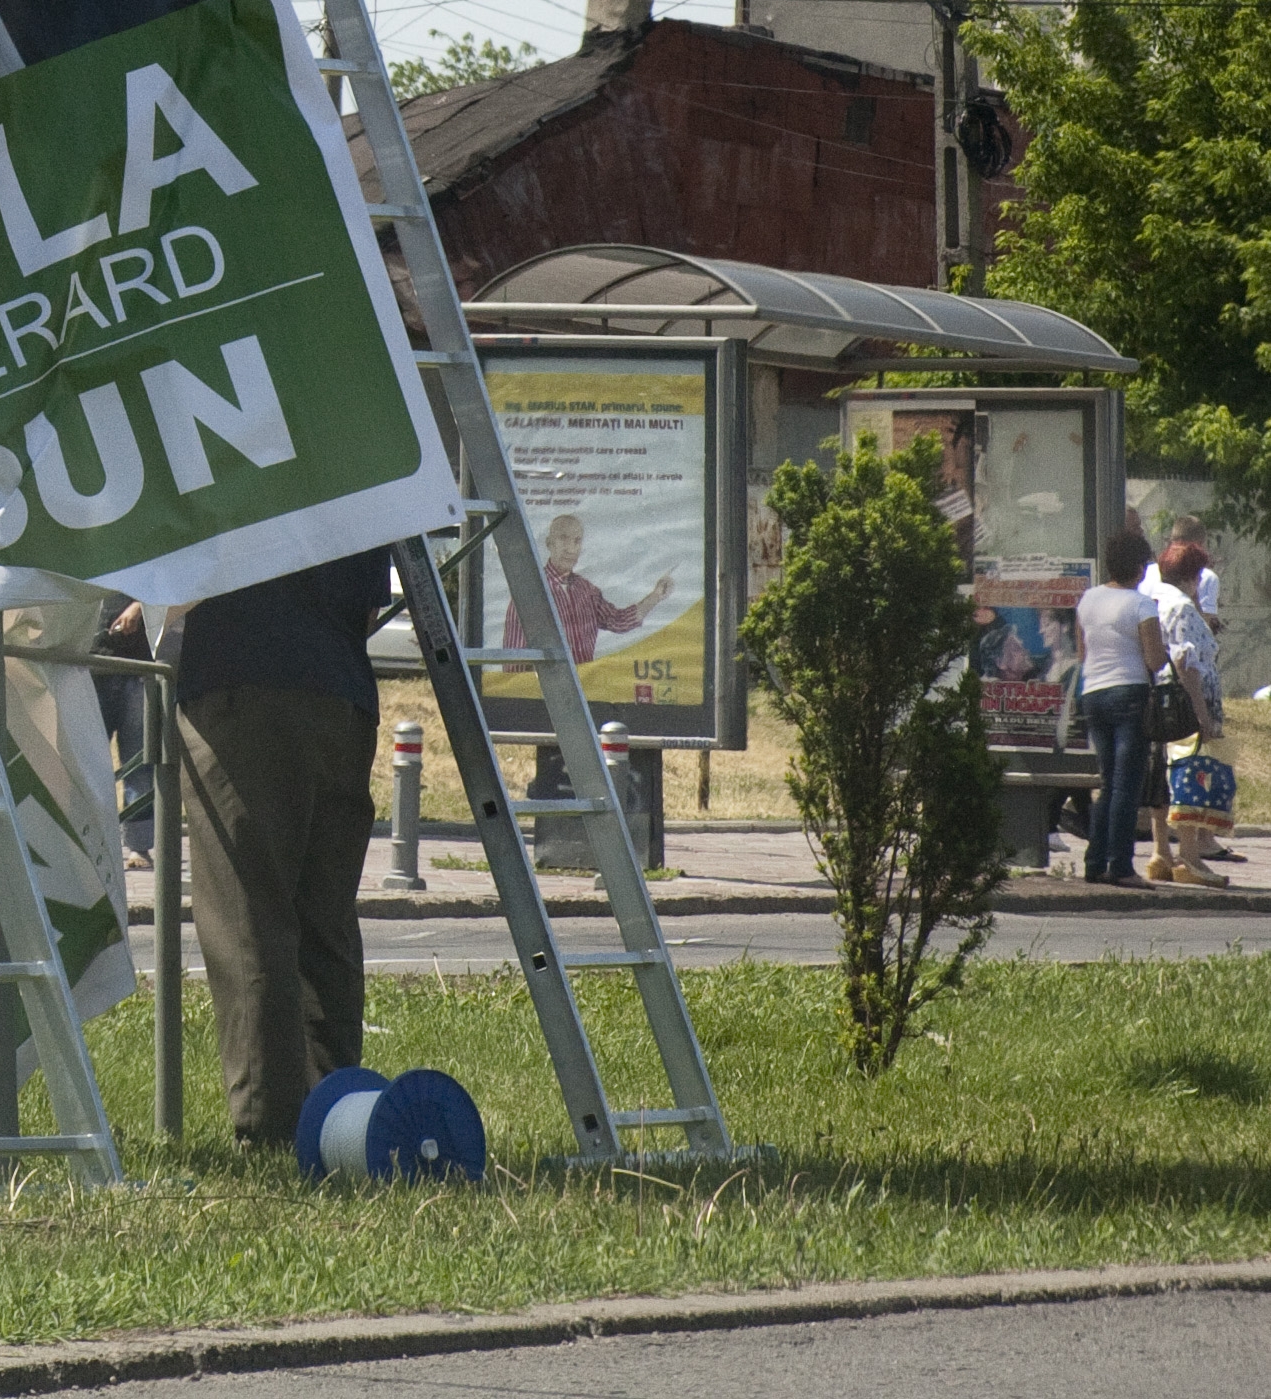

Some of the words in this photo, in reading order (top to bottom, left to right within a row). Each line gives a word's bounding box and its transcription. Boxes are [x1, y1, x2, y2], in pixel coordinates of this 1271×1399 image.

[624, 418, 645, 429] MAI
[649, 418, 684, 430] MULT!
[633, 659, 678, 680] USL
